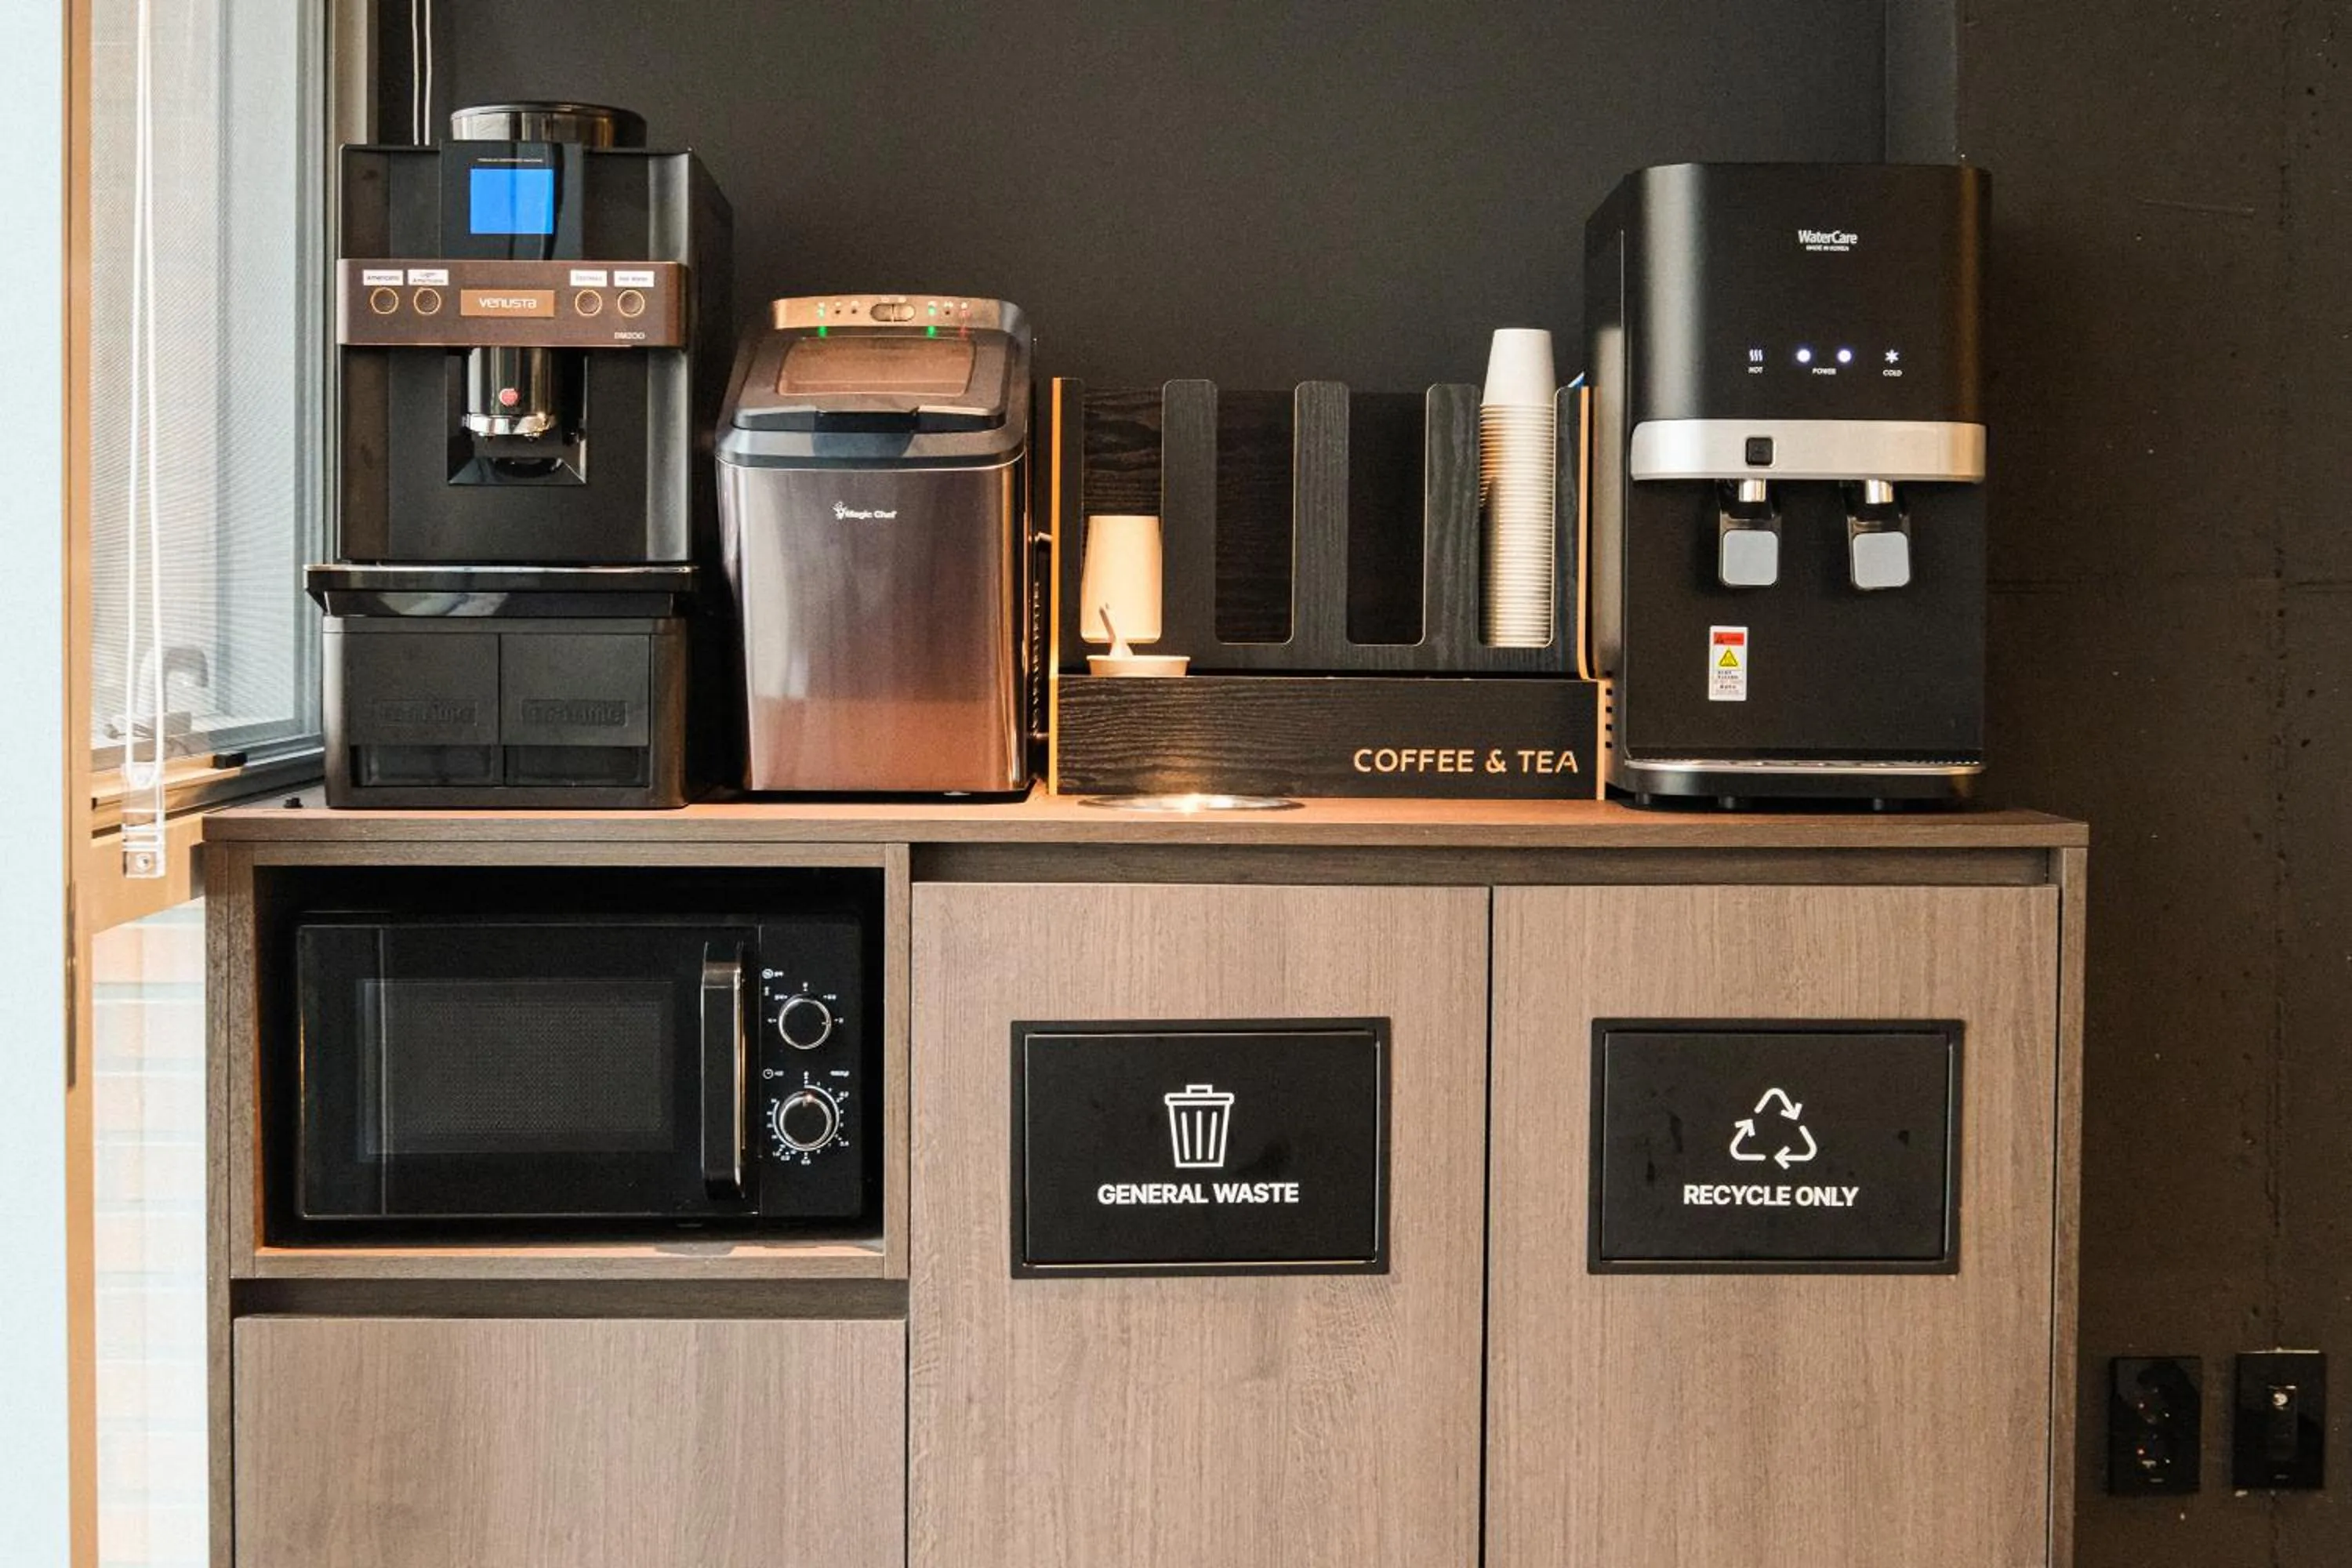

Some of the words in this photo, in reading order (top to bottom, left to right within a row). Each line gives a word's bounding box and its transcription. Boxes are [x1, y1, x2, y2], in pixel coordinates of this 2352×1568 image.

[1798, 230, 1858, 245] WaterCare
[1812, 367, 1837, 376] POWER
[1353, 748, 1475, 772] COFFEE
[1485, 750, 1507, 774] &
[1517, 750, 1579, 774] TEA
[1097, 1183, 1210, 1204] GENERAL
[1212, 1182, 1300, 1203] WASTE
[1683, 1184, 1791, 1206] RECYCLE
[1795, 1185, 1860, 1207] ONLY
